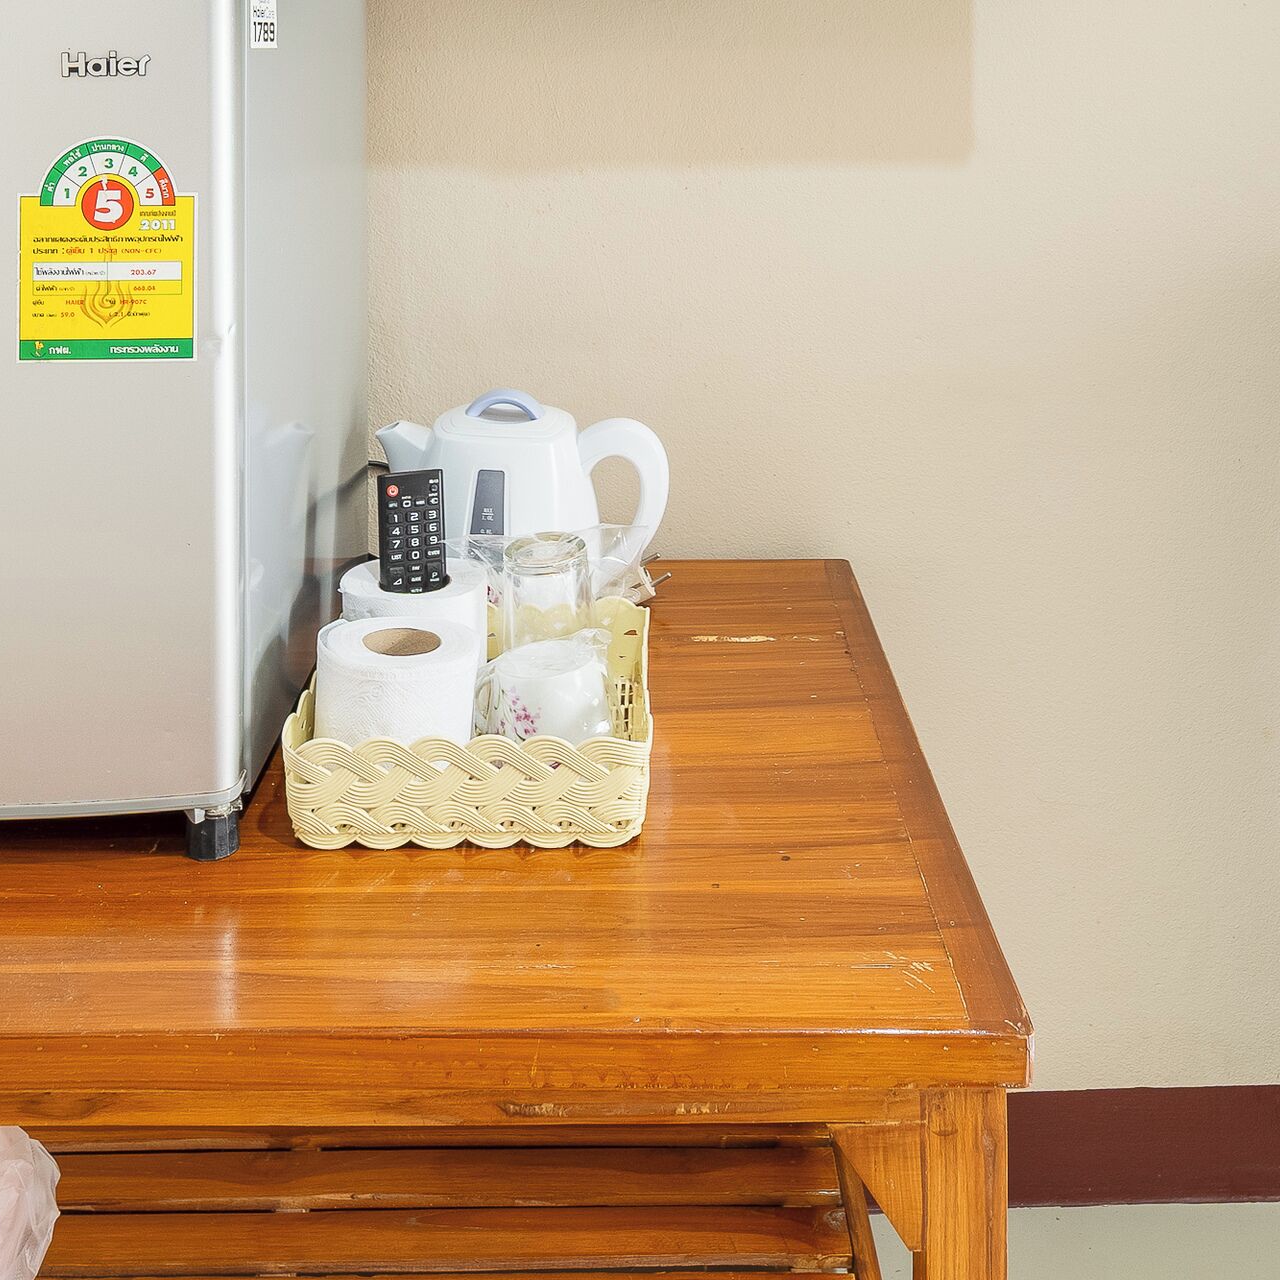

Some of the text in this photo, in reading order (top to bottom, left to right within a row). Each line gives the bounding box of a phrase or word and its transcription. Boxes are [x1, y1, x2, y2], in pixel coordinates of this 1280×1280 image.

[253, 21, 275, 43] 1789
[61, 50, 151, 77] Haier
[64, 158, 155, 199] 1 2 3 4 5
[93, 189, 125, 224] 5
[139, 218, 176, 231] 2011
[393, 510, 437, 523] 1 2 3
[392, 523, 437, 536] 4 5 6
[392, 535, 438, 549] 7 8 9
[411, 550, 420, 559] 0
